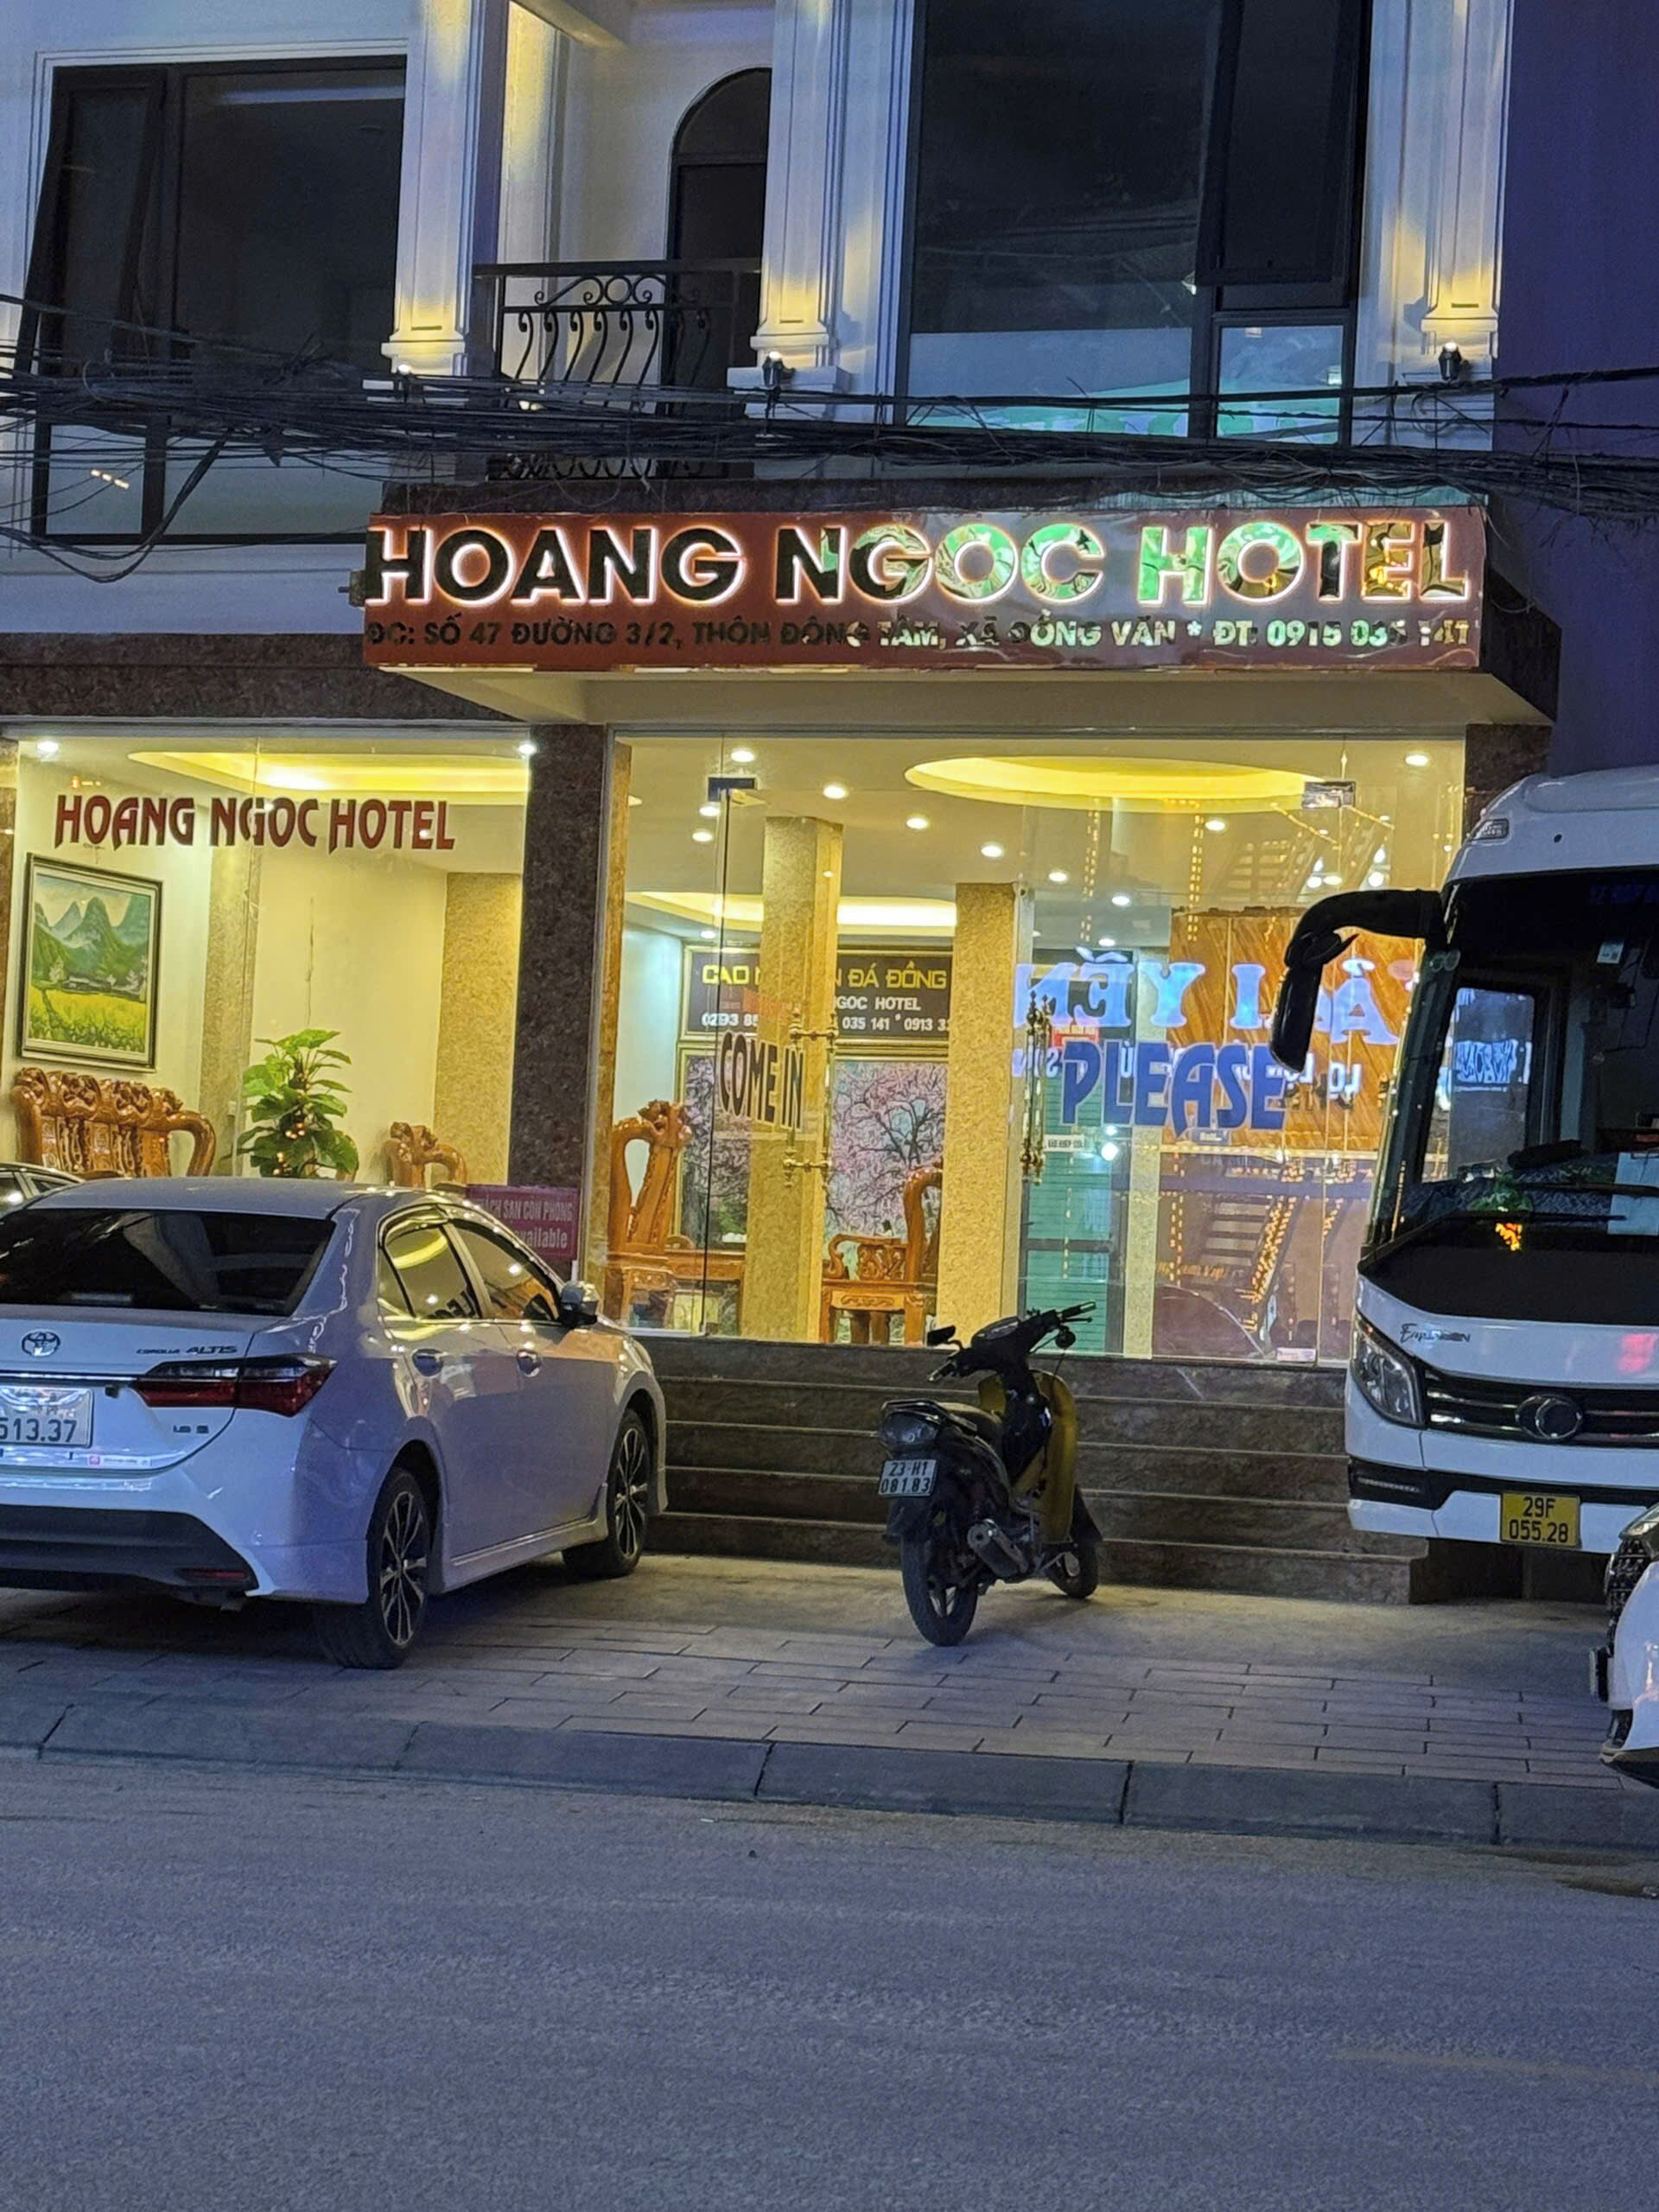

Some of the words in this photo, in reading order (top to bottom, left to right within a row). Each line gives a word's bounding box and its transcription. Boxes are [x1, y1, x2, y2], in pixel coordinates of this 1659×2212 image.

[365, 524, 745, 604] HOANG
[777, 524, 1106, 605] NGOC
[1137, 520, 1471, 606] HOTEL
[424, 612, 462, 645] SỐ
[468, 620, 504, 645] 47
[692, 614, 771, 645] THÔN
[1111, 614, 1176, 646] VĂN
[1266, 620, 1343, 646] 0915
[54, 794, 194, 850] HOANG
[209, 796, 320, 849] NGOC
[328, 798, 455, 855] HOTEL
[702, 963, 750, 986] CAO
[835, 995, 868, 1010] GOC
[874, 996, 922, 1011] HOTEL
[870, 1017, 891, 1031] 141
[904, 1018, 933, 1031] 0913
[719, 1031, 778, 1124] COME
[780, 1046, 804, 1130] IN
[1061, 1039, 1288, 1138] PLEASE
[185, 1345, 238, 1355] ALTIS
[1522, 1496, 1556, 1518] 29F
[1509, 1518, 1569, 1543] 055.28
